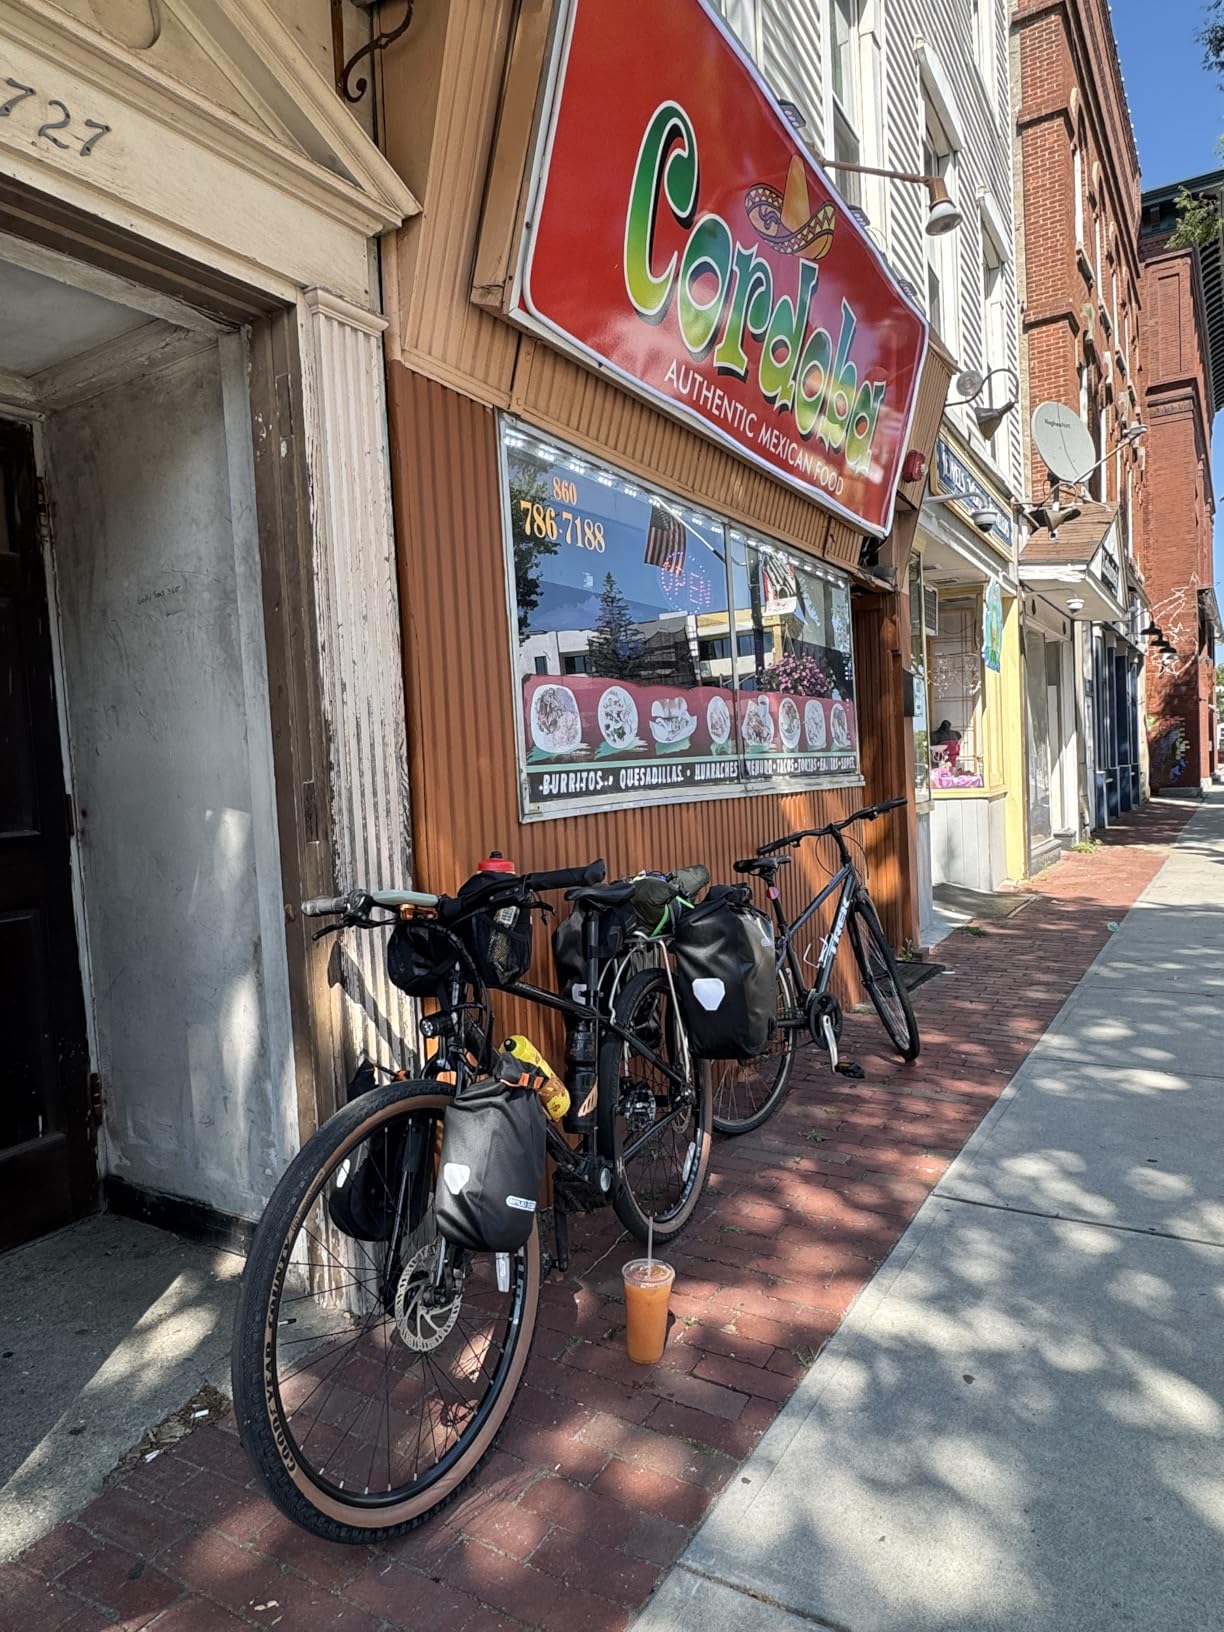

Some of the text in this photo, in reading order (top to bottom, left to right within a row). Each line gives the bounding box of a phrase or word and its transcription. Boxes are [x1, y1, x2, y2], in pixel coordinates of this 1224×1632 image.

[0, 78, 112, 156] 727
[623, 100, 885, 474] Cordoba
[664, 358, 844, 497] AUTHENTIC MEXICAN FOOD
[552, 476, 578, 506] 860
[542, 770, 603, 796] BURRITOS
[619, 764, 684, 790] QUESADILLAS
[694, 761, 738, 781] HUARACHES
[776, 758, 796, 775] TACOS
[828, 897, 850, 954] TREK
[264, 1342, 297, 1472] GOODYEAR
